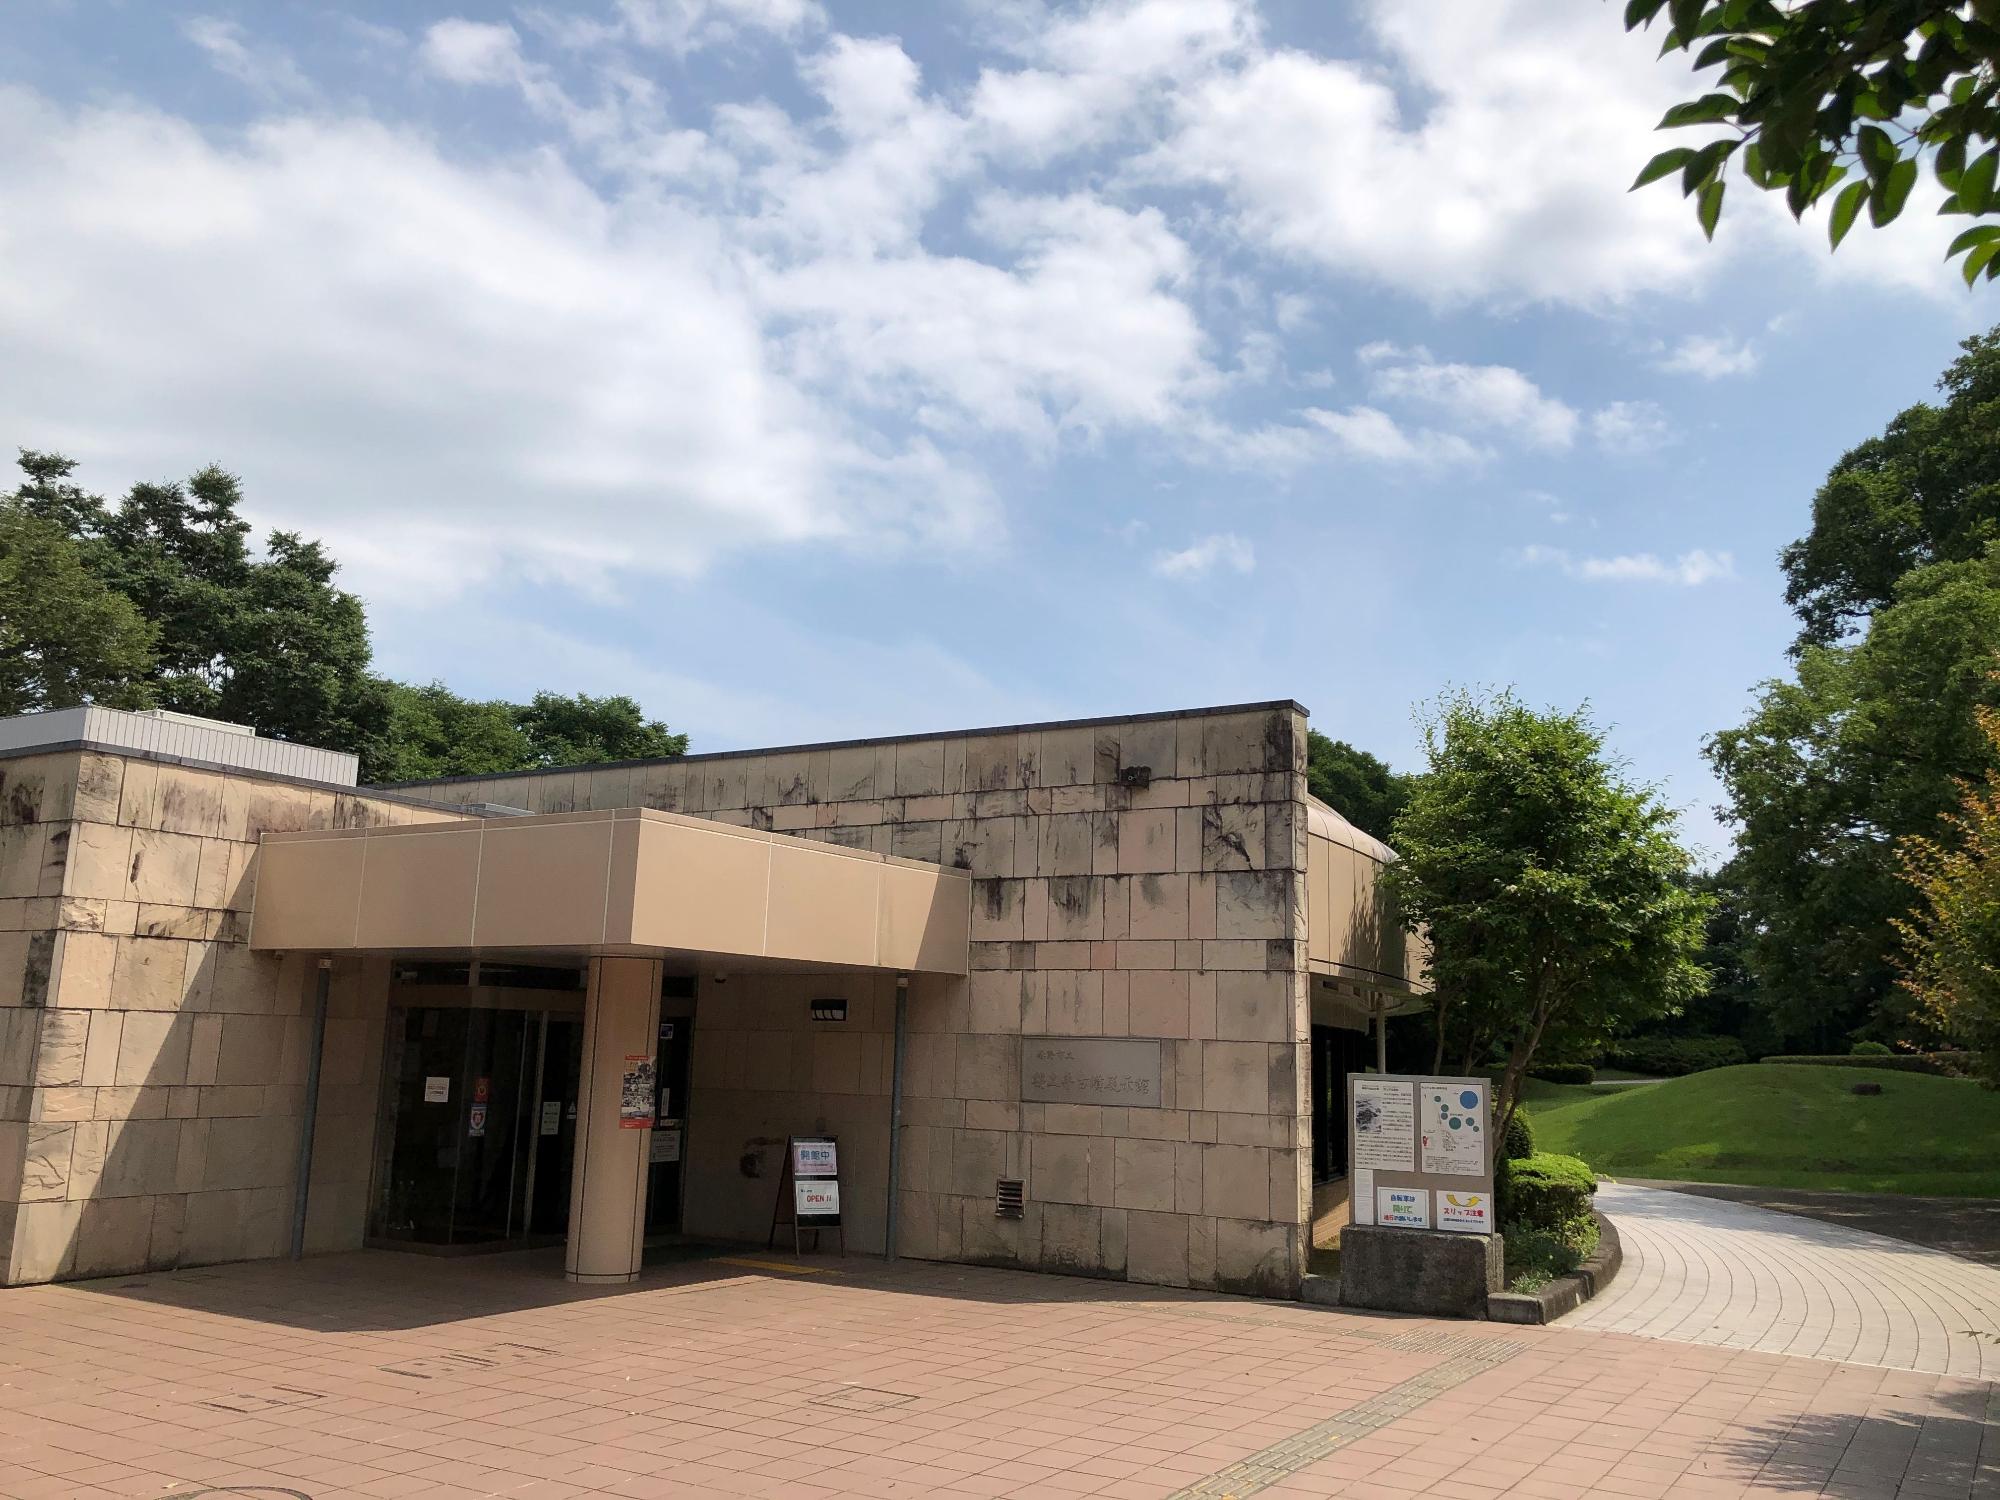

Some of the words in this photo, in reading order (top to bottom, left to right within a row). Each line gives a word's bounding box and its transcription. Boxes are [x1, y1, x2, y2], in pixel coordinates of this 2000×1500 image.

[800, 1150, 830, 1161] 開館中
[806, 1195, 824, 1203] OPEN
[1443, 1207, 1484, 1218] スリップ注意
